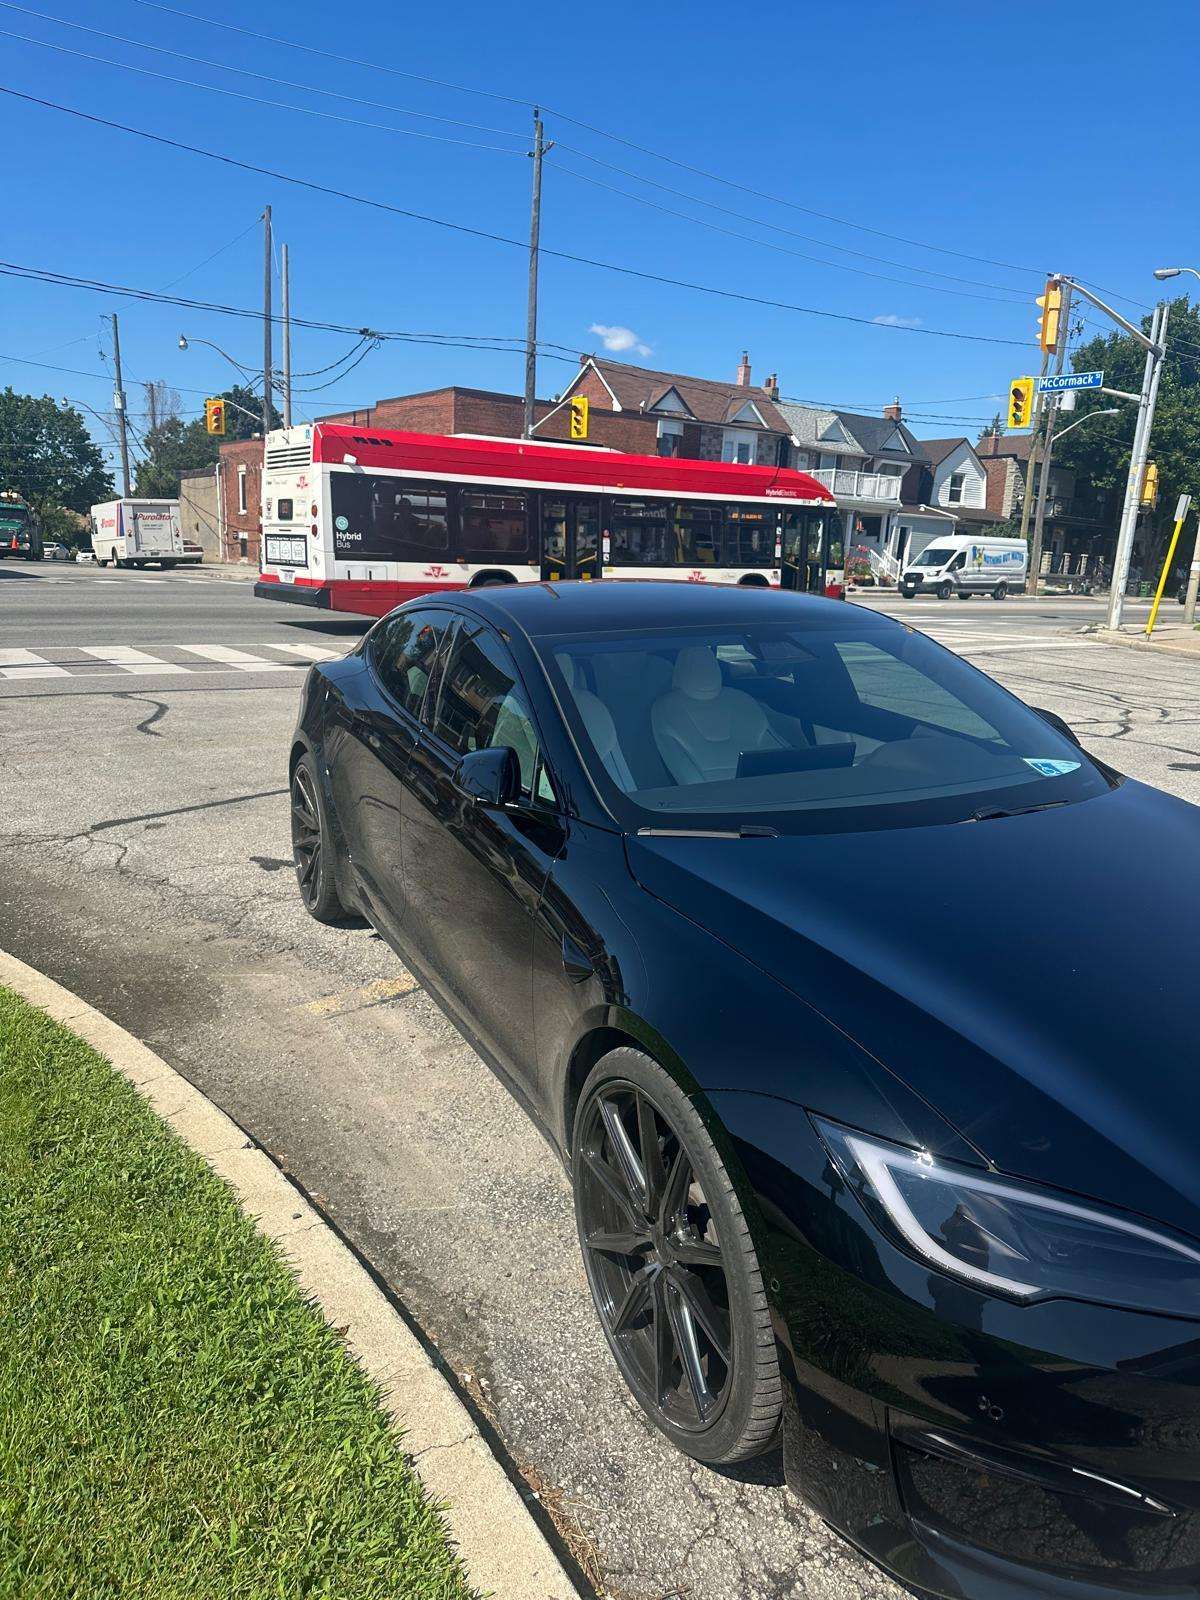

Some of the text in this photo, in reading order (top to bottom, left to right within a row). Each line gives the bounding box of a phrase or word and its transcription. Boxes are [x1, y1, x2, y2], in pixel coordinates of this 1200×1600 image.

[1040, 374, 1093, 389] McCormack
[137, 513, 174, 521] Purolator
[336, 531, 362, 541] Hybrid
[336, 541, 351, 549] Bus
